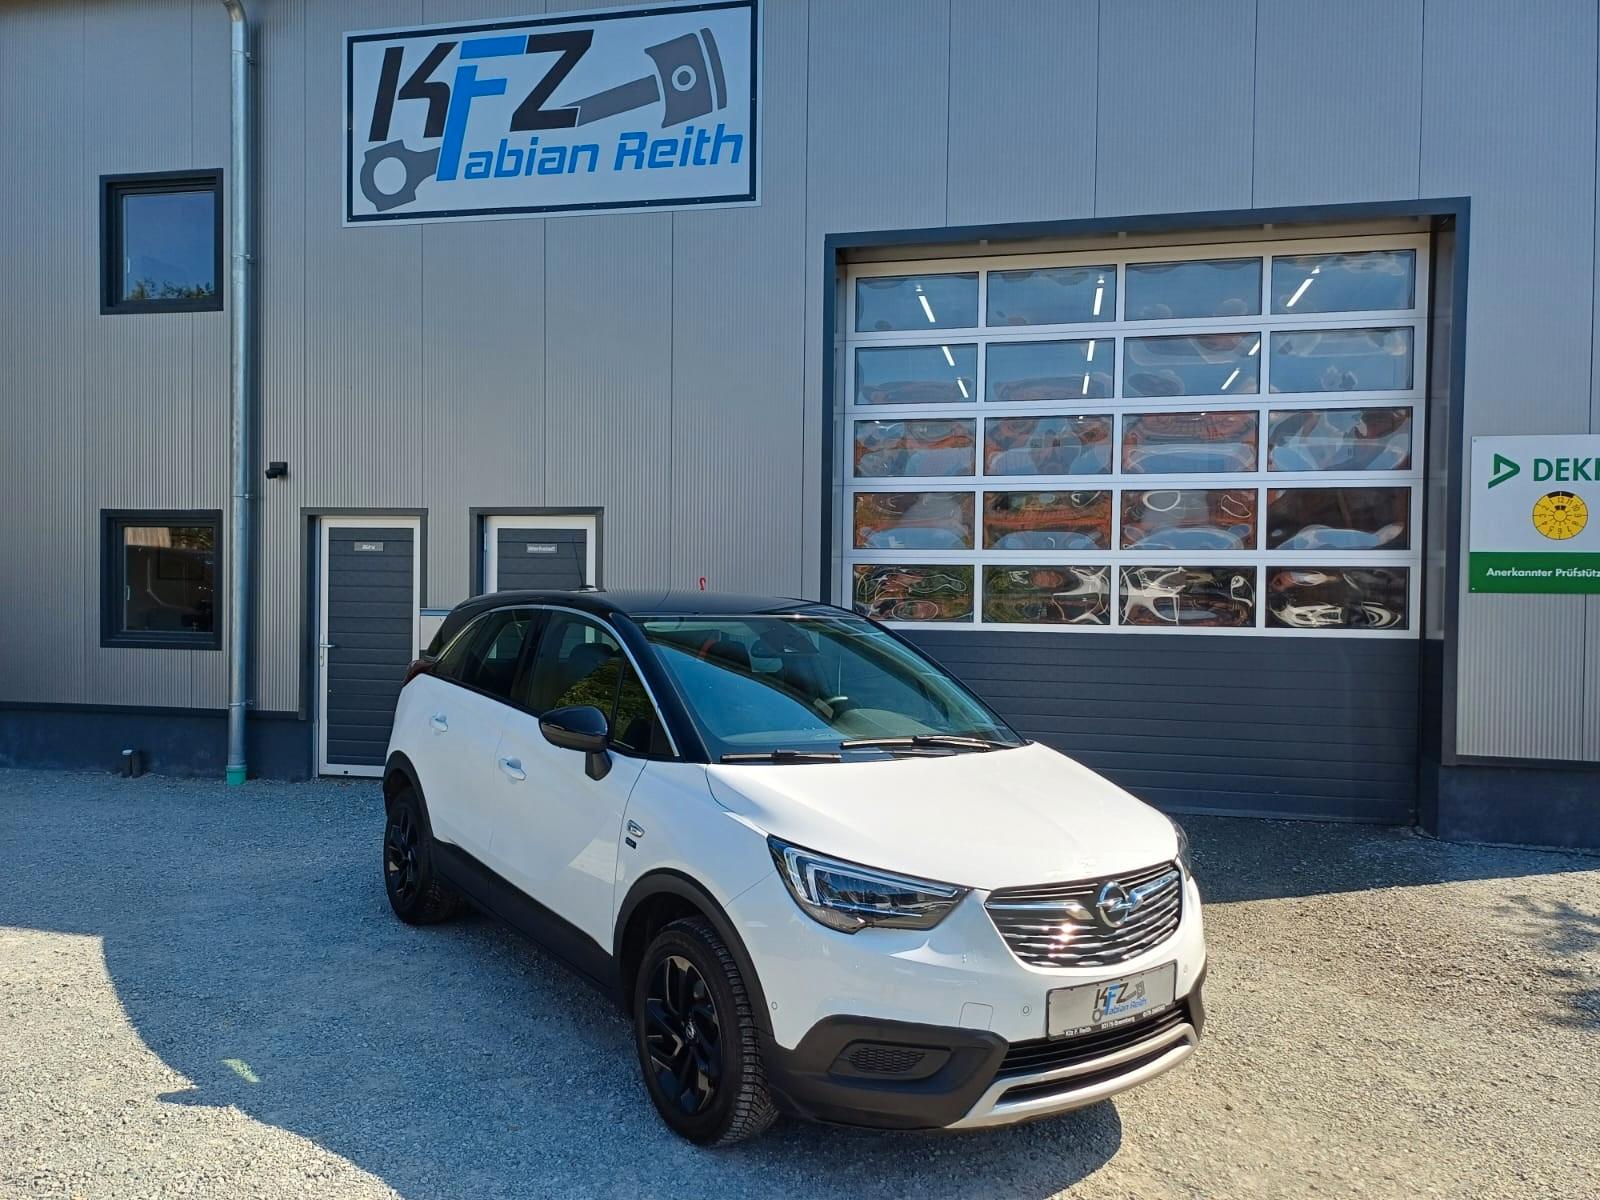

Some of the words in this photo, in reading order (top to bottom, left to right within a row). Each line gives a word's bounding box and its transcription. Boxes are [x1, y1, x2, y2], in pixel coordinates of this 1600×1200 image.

[368, 29, 594, 181] KFZ
[613, 123, 743, 172] Reith
[1486, 567, 1553, 577] Anerkannter
